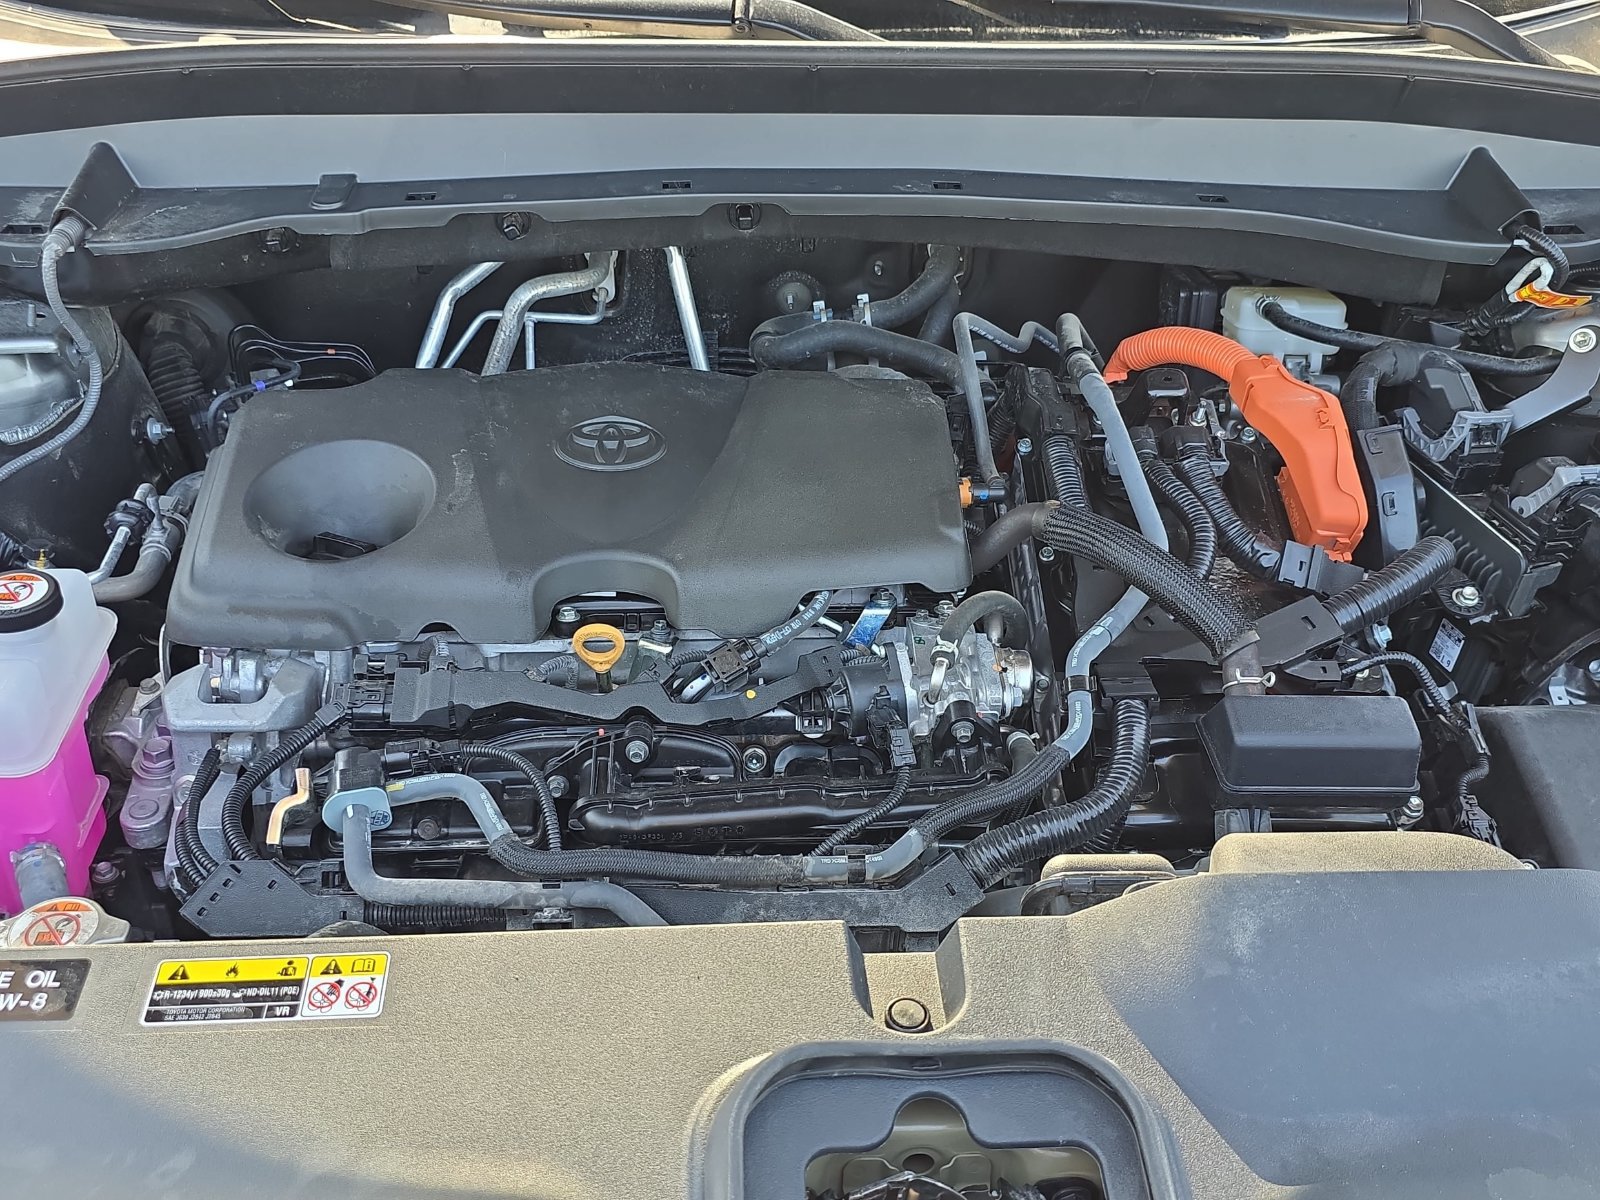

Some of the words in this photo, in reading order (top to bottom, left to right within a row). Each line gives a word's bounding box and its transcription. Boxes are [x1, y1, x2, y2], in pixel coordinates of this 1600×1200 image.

[25, 969, 61, 989] OIL
[280, 985, 300, 997] (POE)
[207, 1006, 246, 1014] CORPORATION
[275, 1005, 291, 1017] VR
